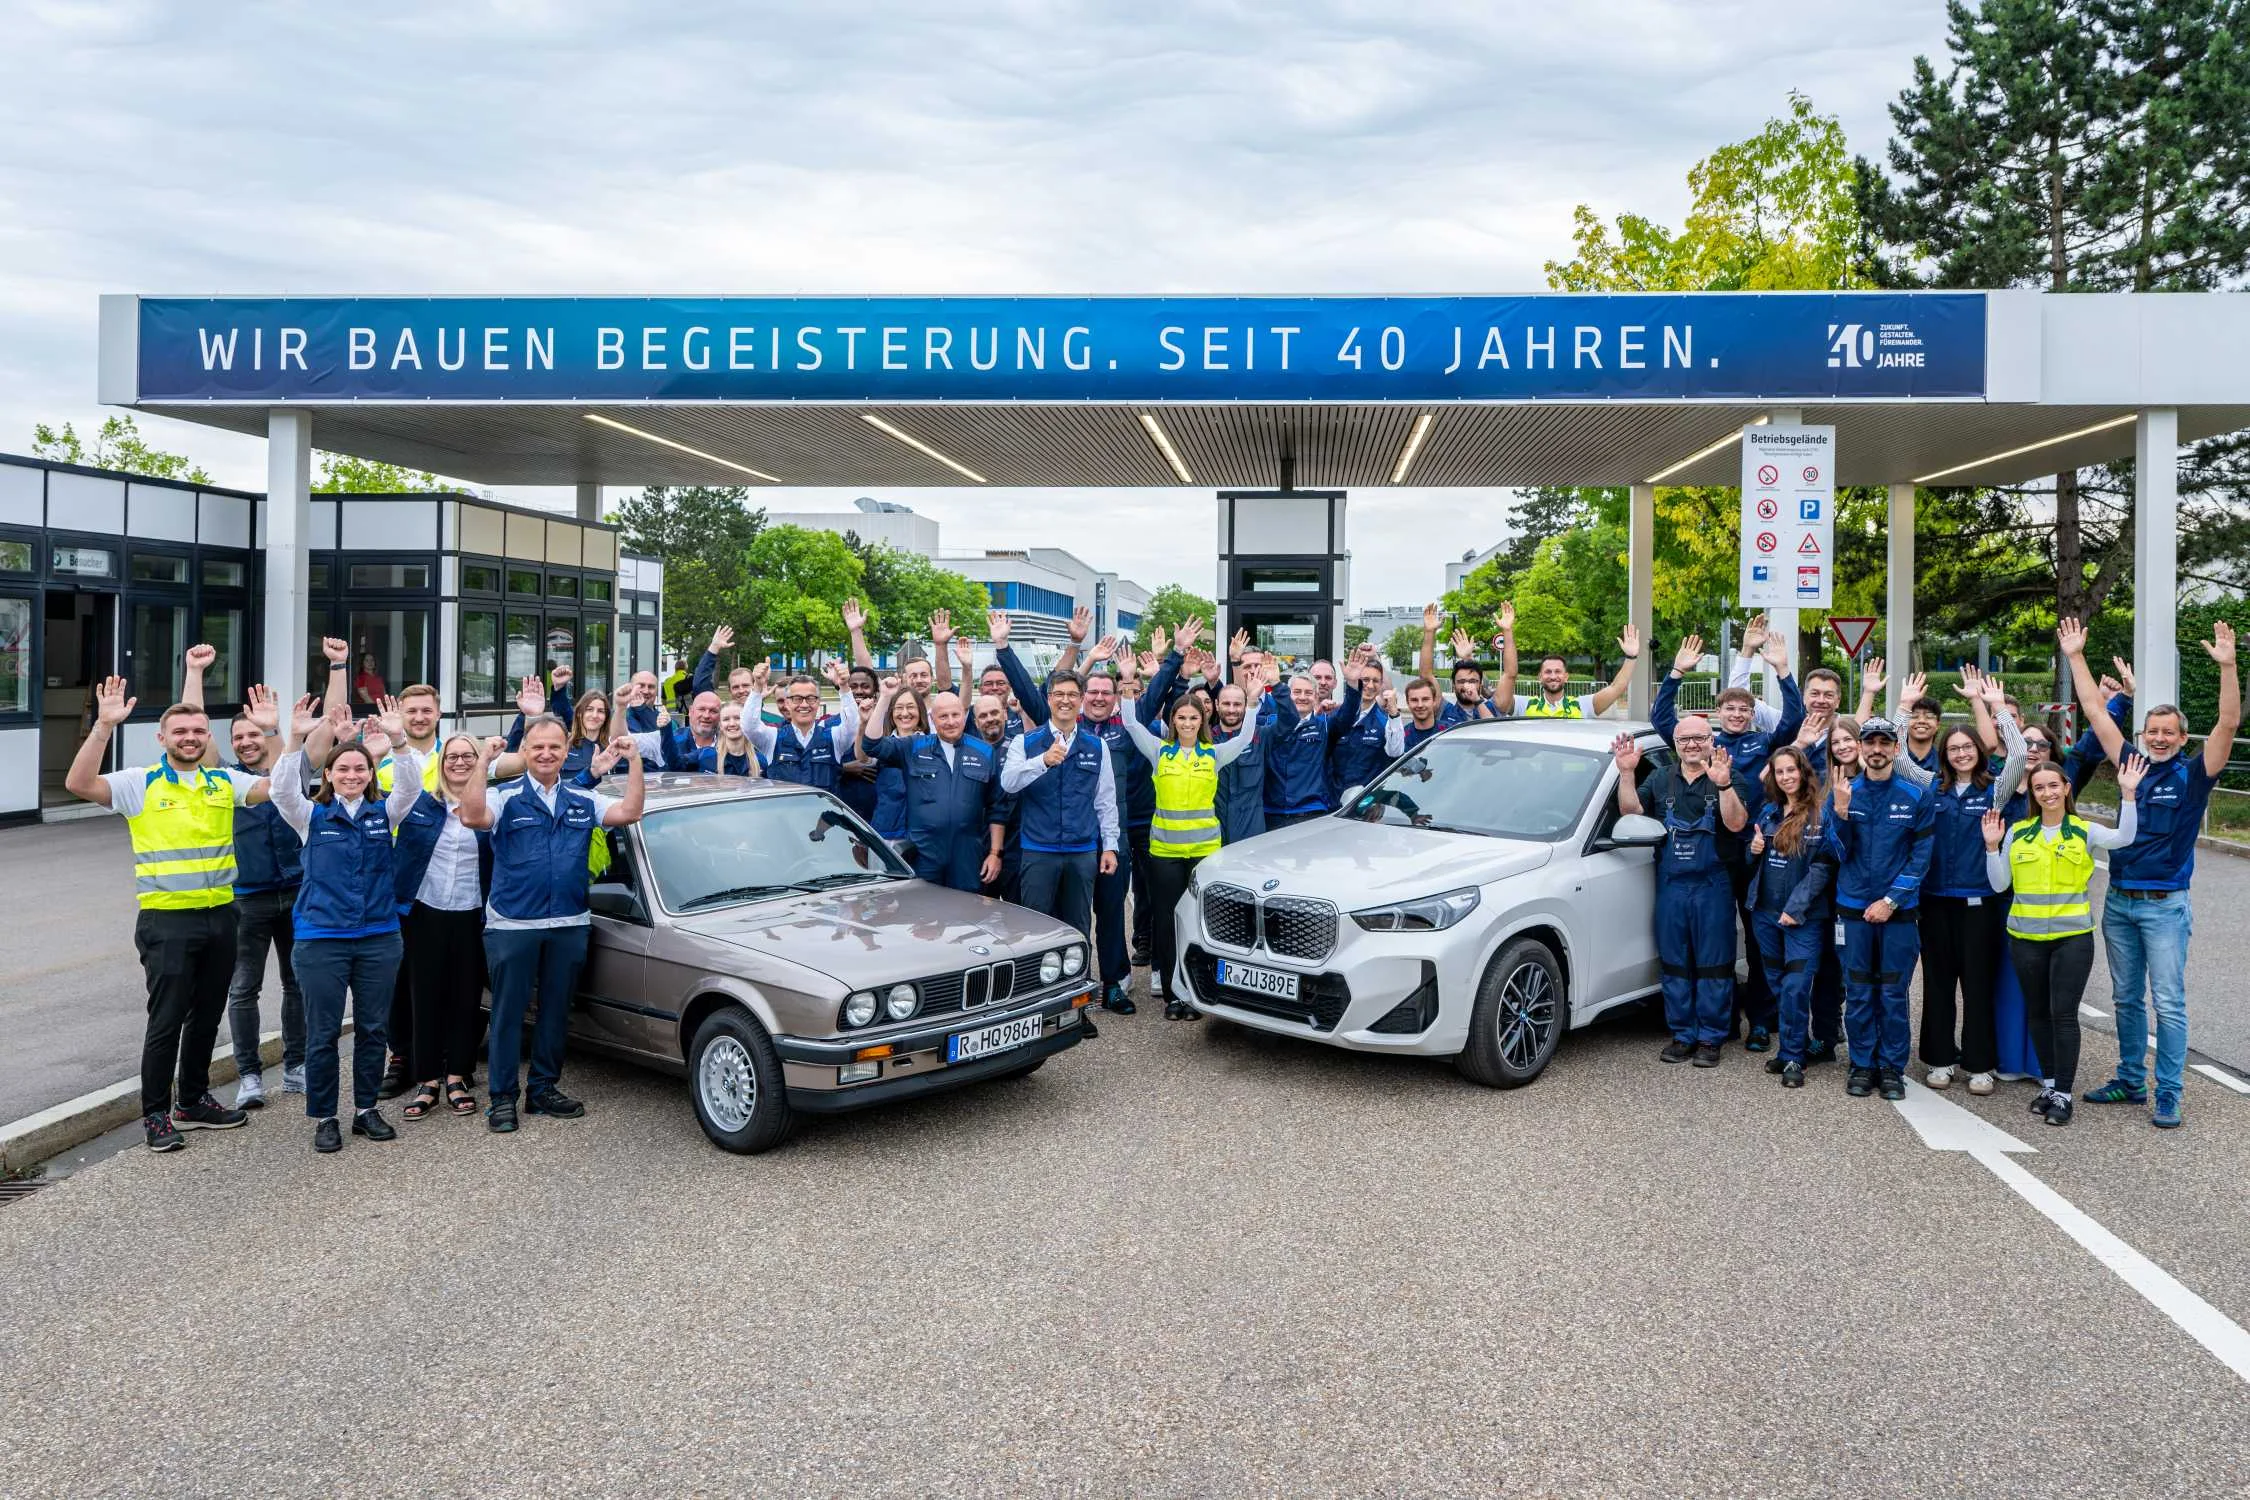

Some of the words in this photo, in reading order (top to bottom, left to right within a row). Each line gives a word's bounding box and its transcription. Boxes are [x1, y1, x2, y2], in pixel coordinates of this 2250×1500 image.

[198, 327, 309, 371] WIR
[349, 327, 554, 371] BAUEN
[597, 326, 1118, 371] BEGEISTERUNG.
[1159, 326, 1301, 371] SEIT
[1337, 326, 1405, 371] 40
[1444, 325, 1719, 374] JAHREN.
[1827, 323, 1874, 368] 40
[1876, 353, 1925, 369] JAHRE
[1751, 433, 1828, 446] Betriebsgelände
[1806, 470, 1816, 478] 30
[1803, 501, 1817, 518] P
